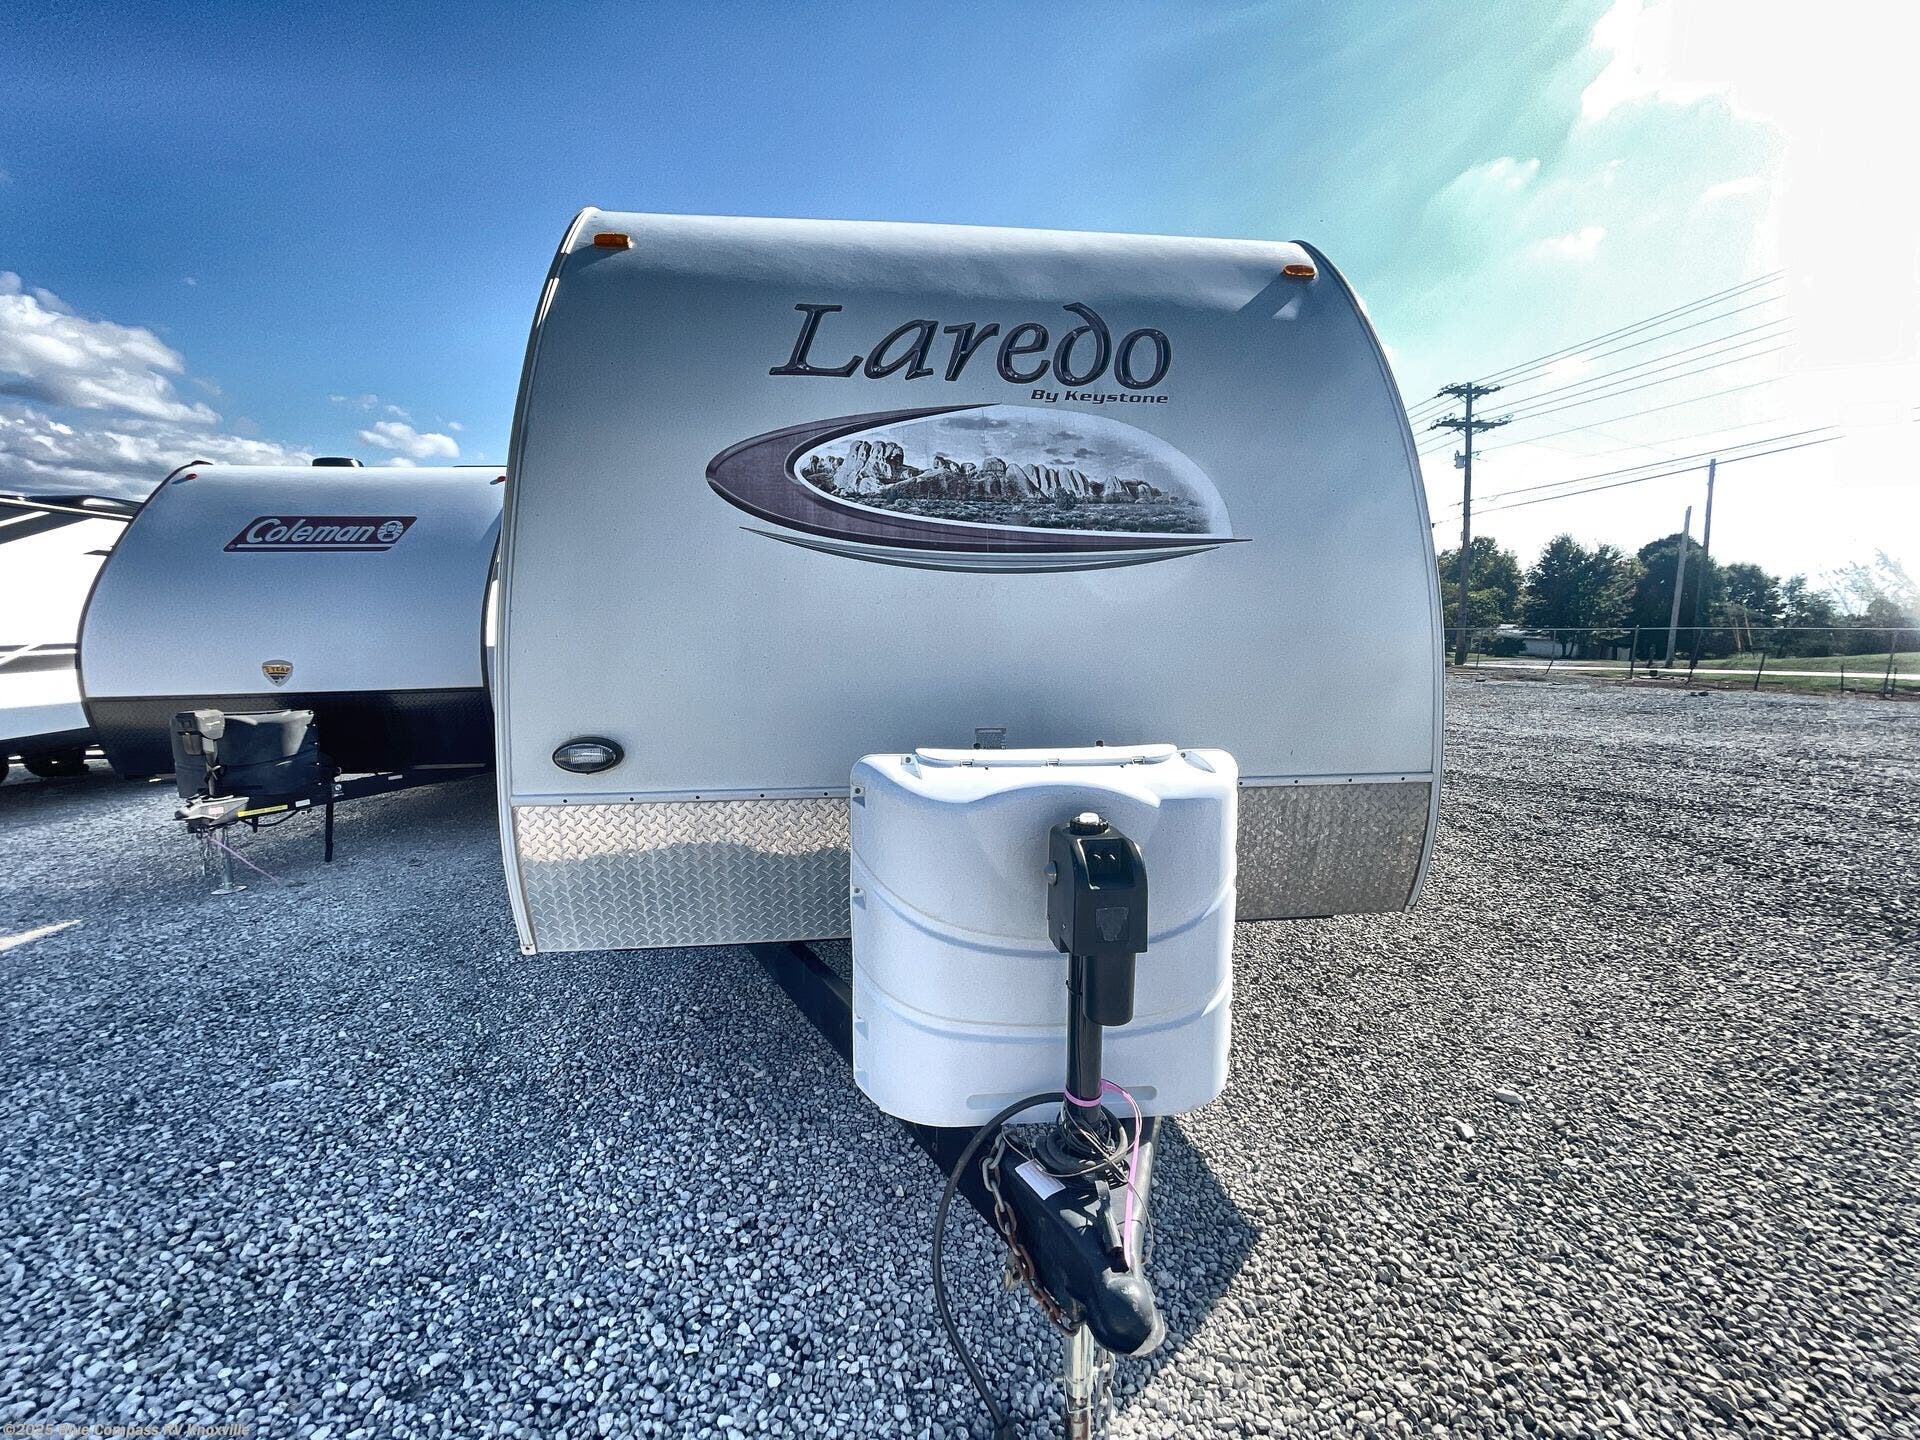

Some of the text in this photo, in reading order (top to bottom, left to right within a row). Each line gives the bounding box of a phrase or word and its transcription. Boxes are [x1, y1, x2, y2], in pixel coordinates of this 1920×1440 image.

[769, 302, 1172, 390] Laredo
[1031, 390, 1169, 404] By Keystone
[246, 518, 376, 543] Coleman
